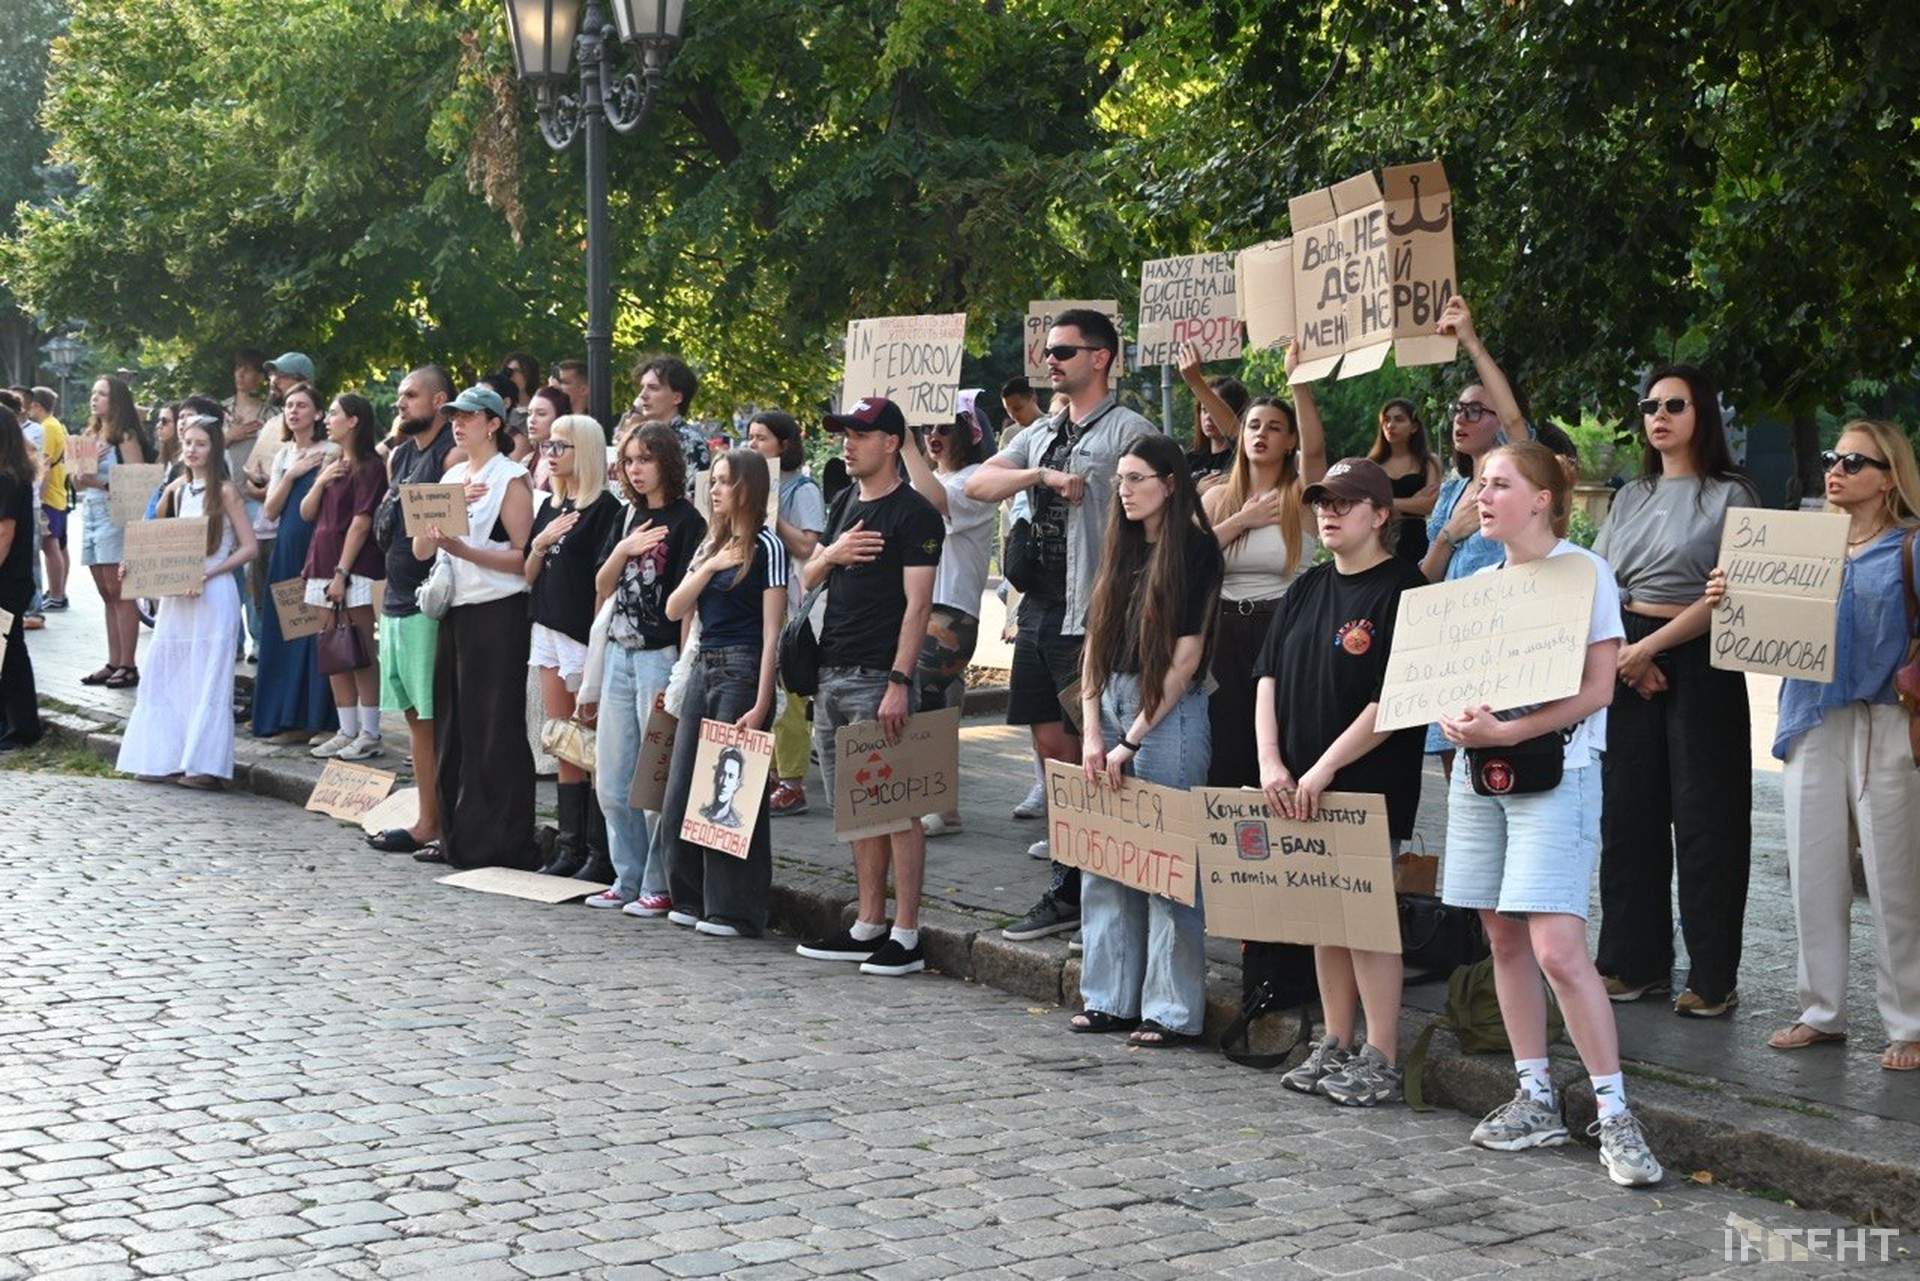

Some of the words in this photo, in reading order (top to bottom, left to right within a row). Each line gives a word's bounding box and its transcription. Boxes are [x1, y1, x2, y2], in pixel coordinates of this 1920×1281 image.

[1354, 209, 1388, 254] НЕ
[1146, 257, 1194, 279] НАХУЯ
[1141, 297, 1212, 323] ПРАЦЮЄ
[1173, 316, 1242, 342] ПРОТИ
[1302, 308, 1348, 350] МЕНІ
[872, 341, 961, 379] FEDOROV
[907, 381, 959, 416] TRUST
[1733, 516, 1767, 549] ЗА
[1719, 596, 1745, 626] ЗА
[699, 720, 772, 756] ПОВЕРНІТЬ
[684, 818, 749, 857] ФЕДОРОВА
[1055, 820, 1184, 900] ПОБОРИТЕ
[1211, 871, 1222, 884] а
